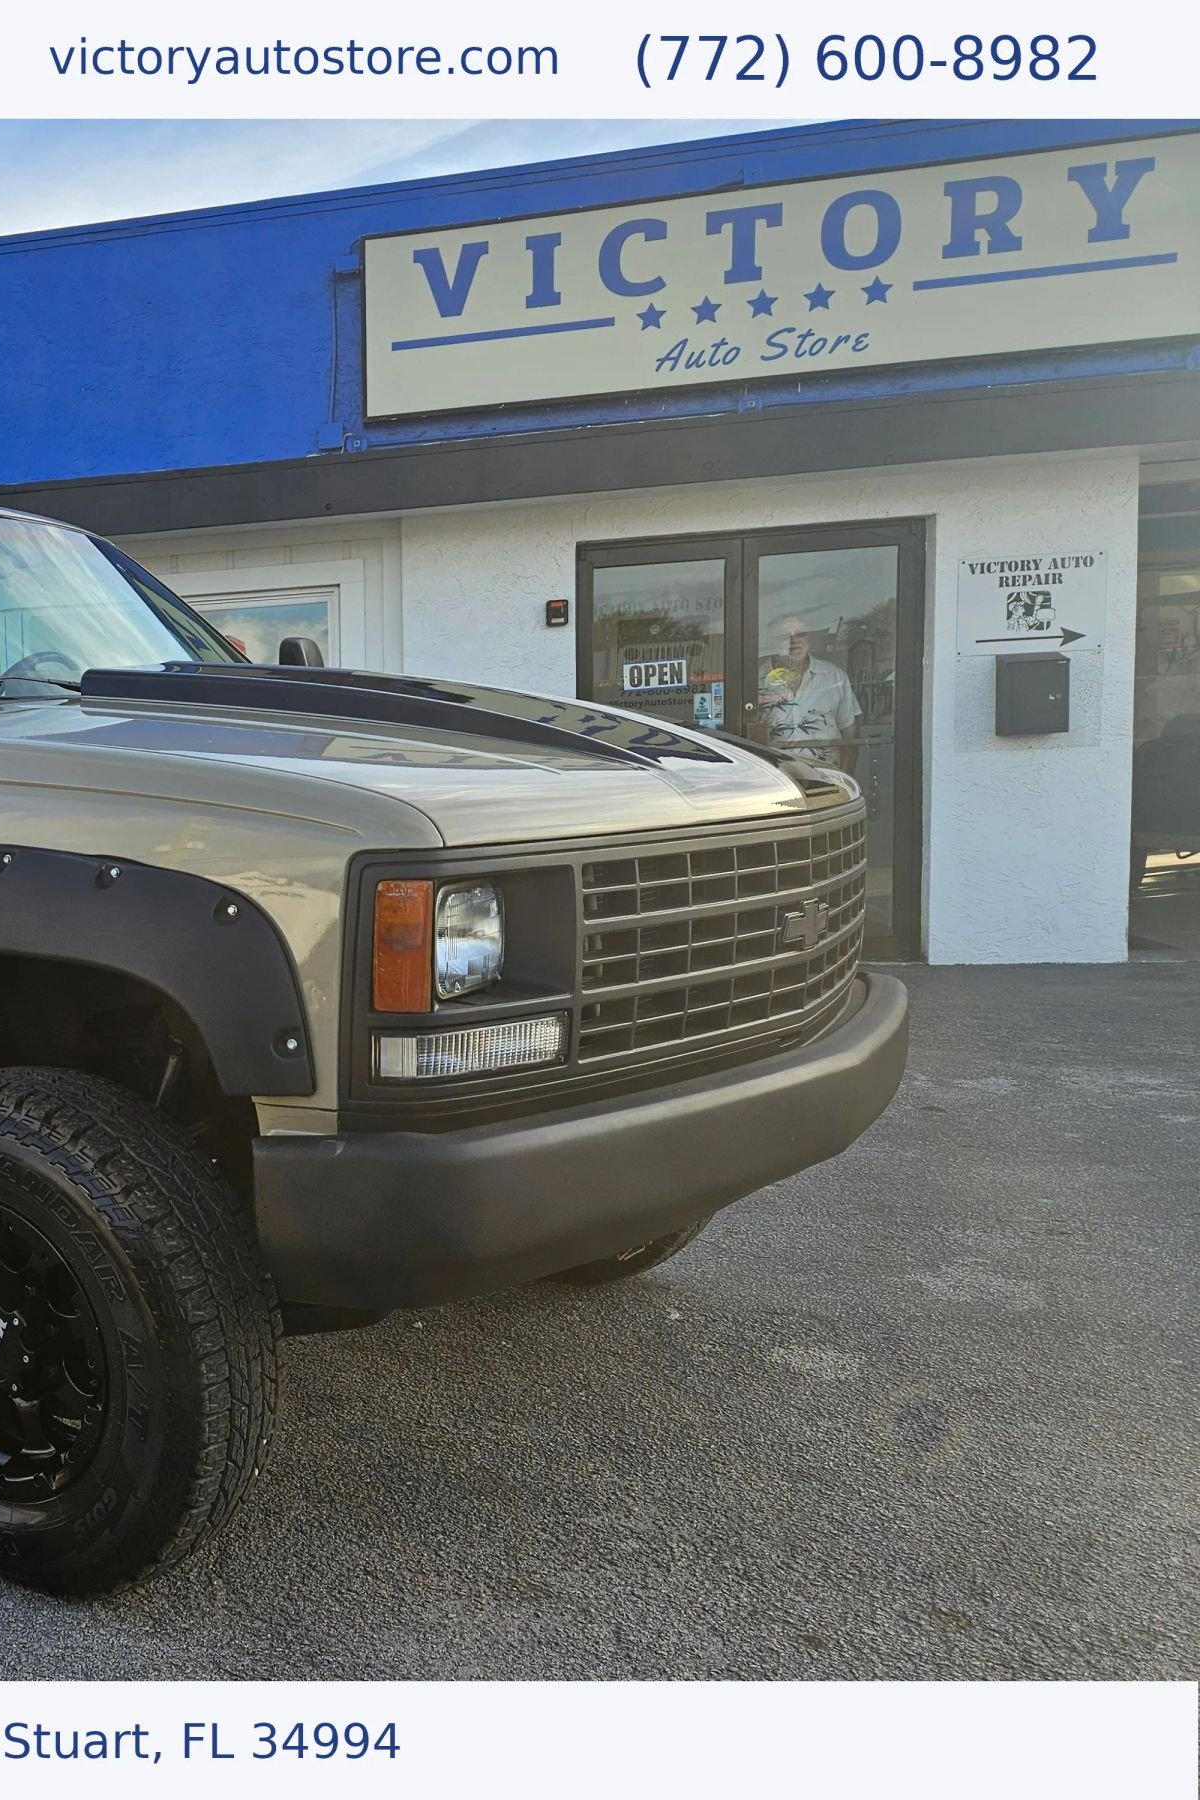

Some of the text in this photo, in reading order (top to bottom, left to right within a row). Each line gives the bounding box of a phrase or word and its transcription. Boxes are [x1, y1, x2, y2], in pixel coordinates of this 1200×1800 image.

[413, 156, 1156, 318] VICTORY
[655, 326, 870, 373] Auto Store
[968, 555, 1095, 575] VICTORY AUTO
[998, 572, 1064, 588] REPAIR
[629, 661, 683, 688] OPEN
